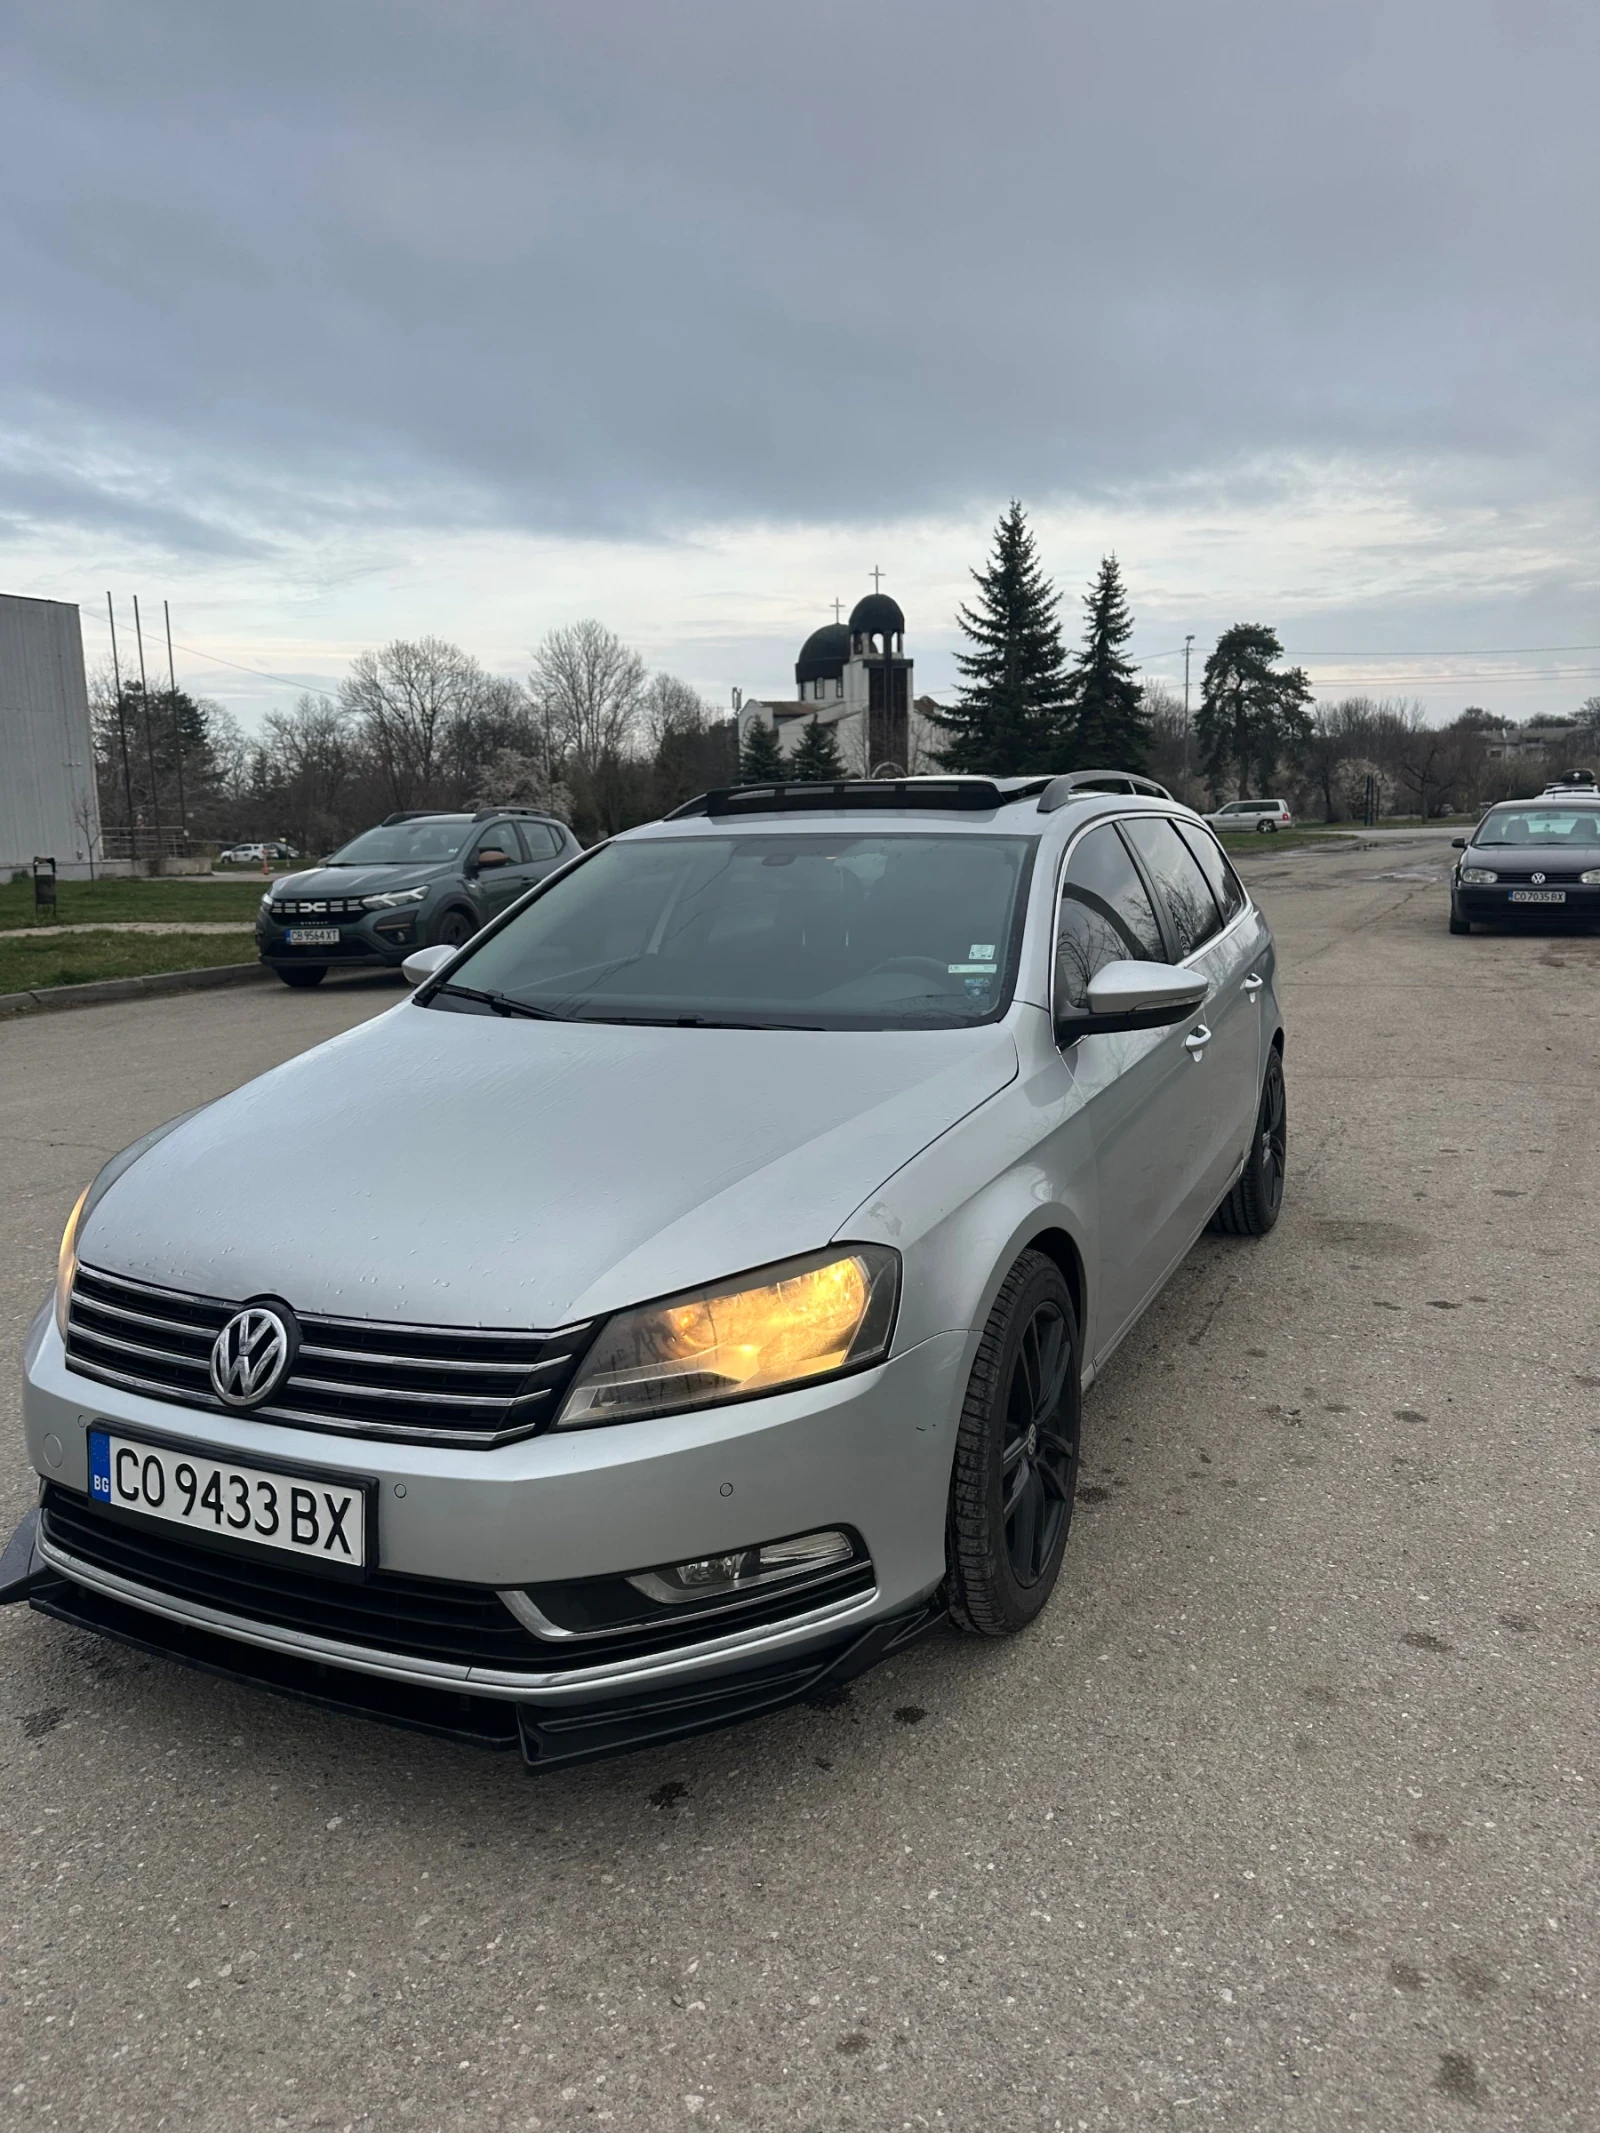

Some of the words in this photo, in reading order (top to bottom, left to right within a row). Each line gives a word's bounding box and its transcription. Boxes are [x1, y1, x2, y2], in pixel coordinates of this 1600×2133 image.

[1514, 892, 1526, 901] CO
[1528, 892, 1550, 901] 7035
[1551, 892, 1563, 902] BX
[304, 930, 325, 941] 9564
[326, 930, 338, 941] XT
[211, 1309, 287, 1404] VW
[93, 1474, 110, 1493] BG
[116, 1447, 165, 1507] CO
[175, 1463, 280, 1536] 9433
[291, 1486, 352, 1555] BX
